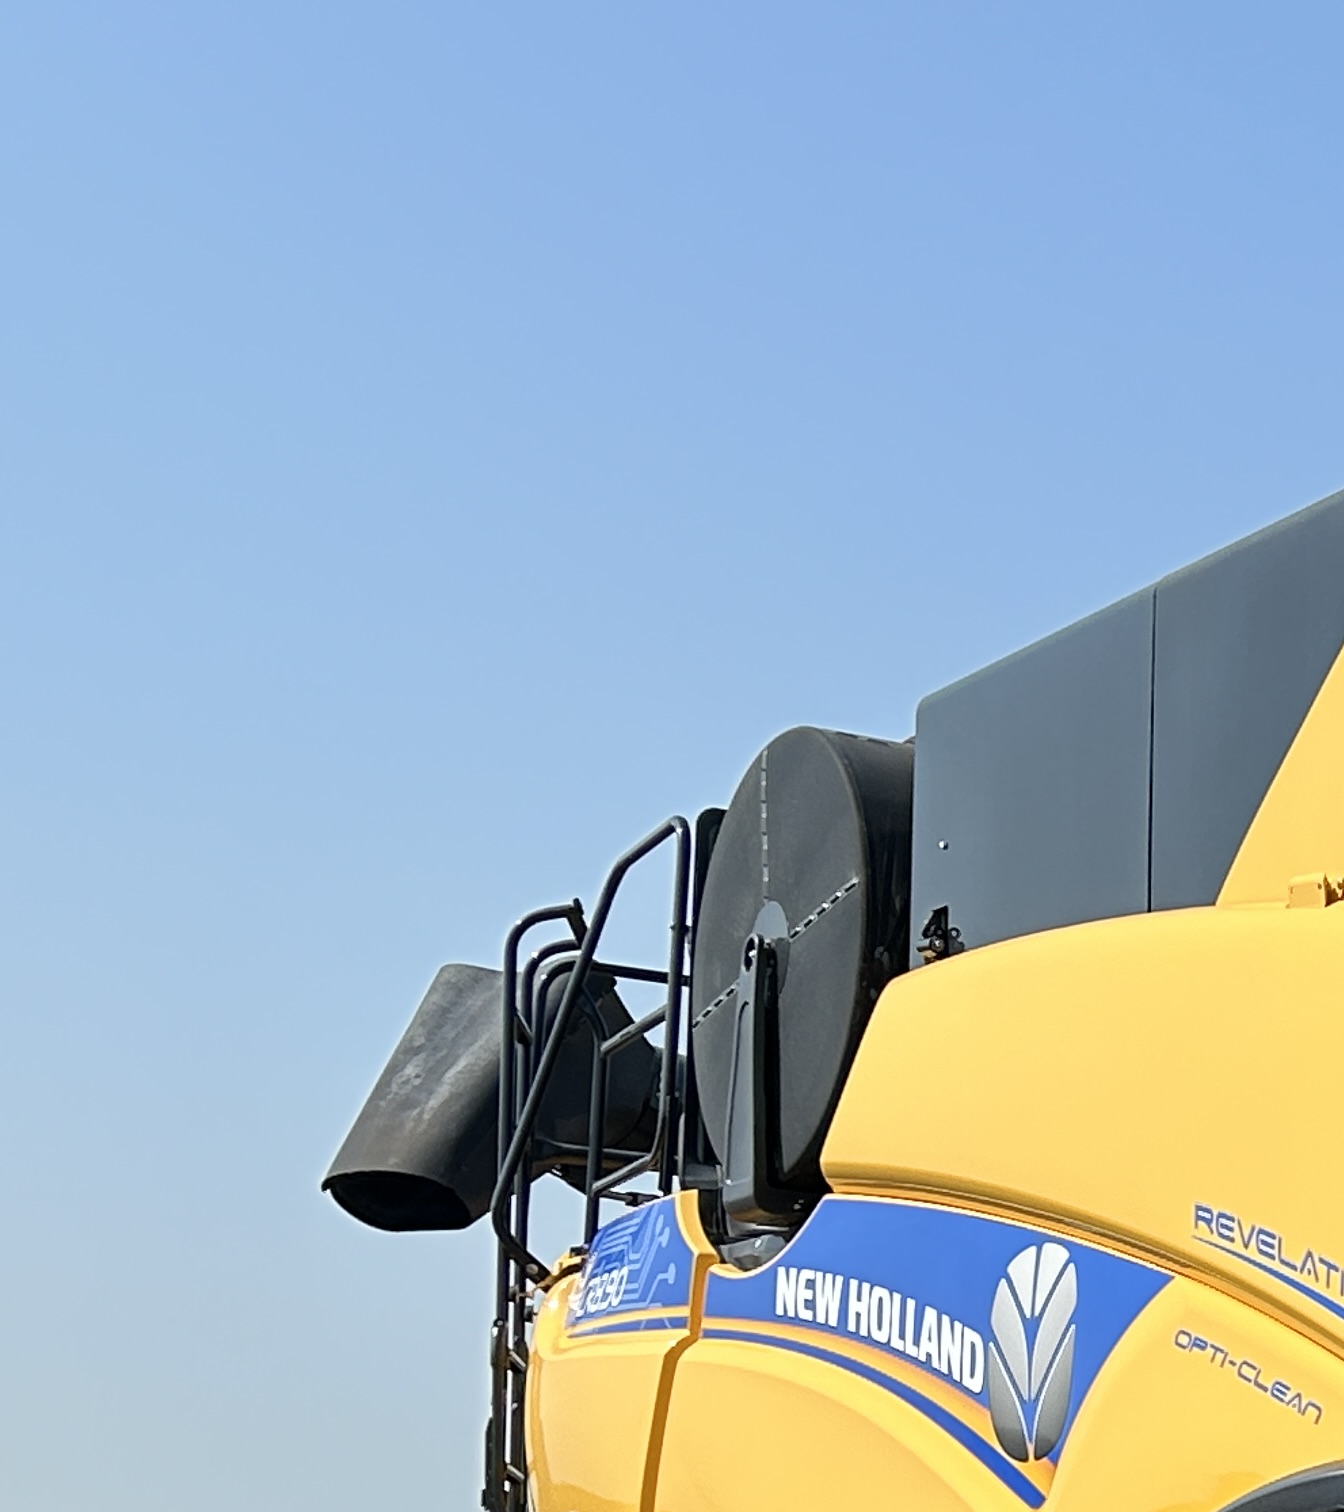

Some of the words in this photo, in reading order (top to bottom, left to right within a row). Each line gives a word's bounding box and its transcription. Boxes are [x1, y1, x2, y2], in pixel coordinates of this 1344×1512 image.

[775, 1266, 844, 1327] NEW
[847, 1278, 985, 1394] HOLLAND
[1174, 1329, 1323, 1425] OPTI-CLEAN
